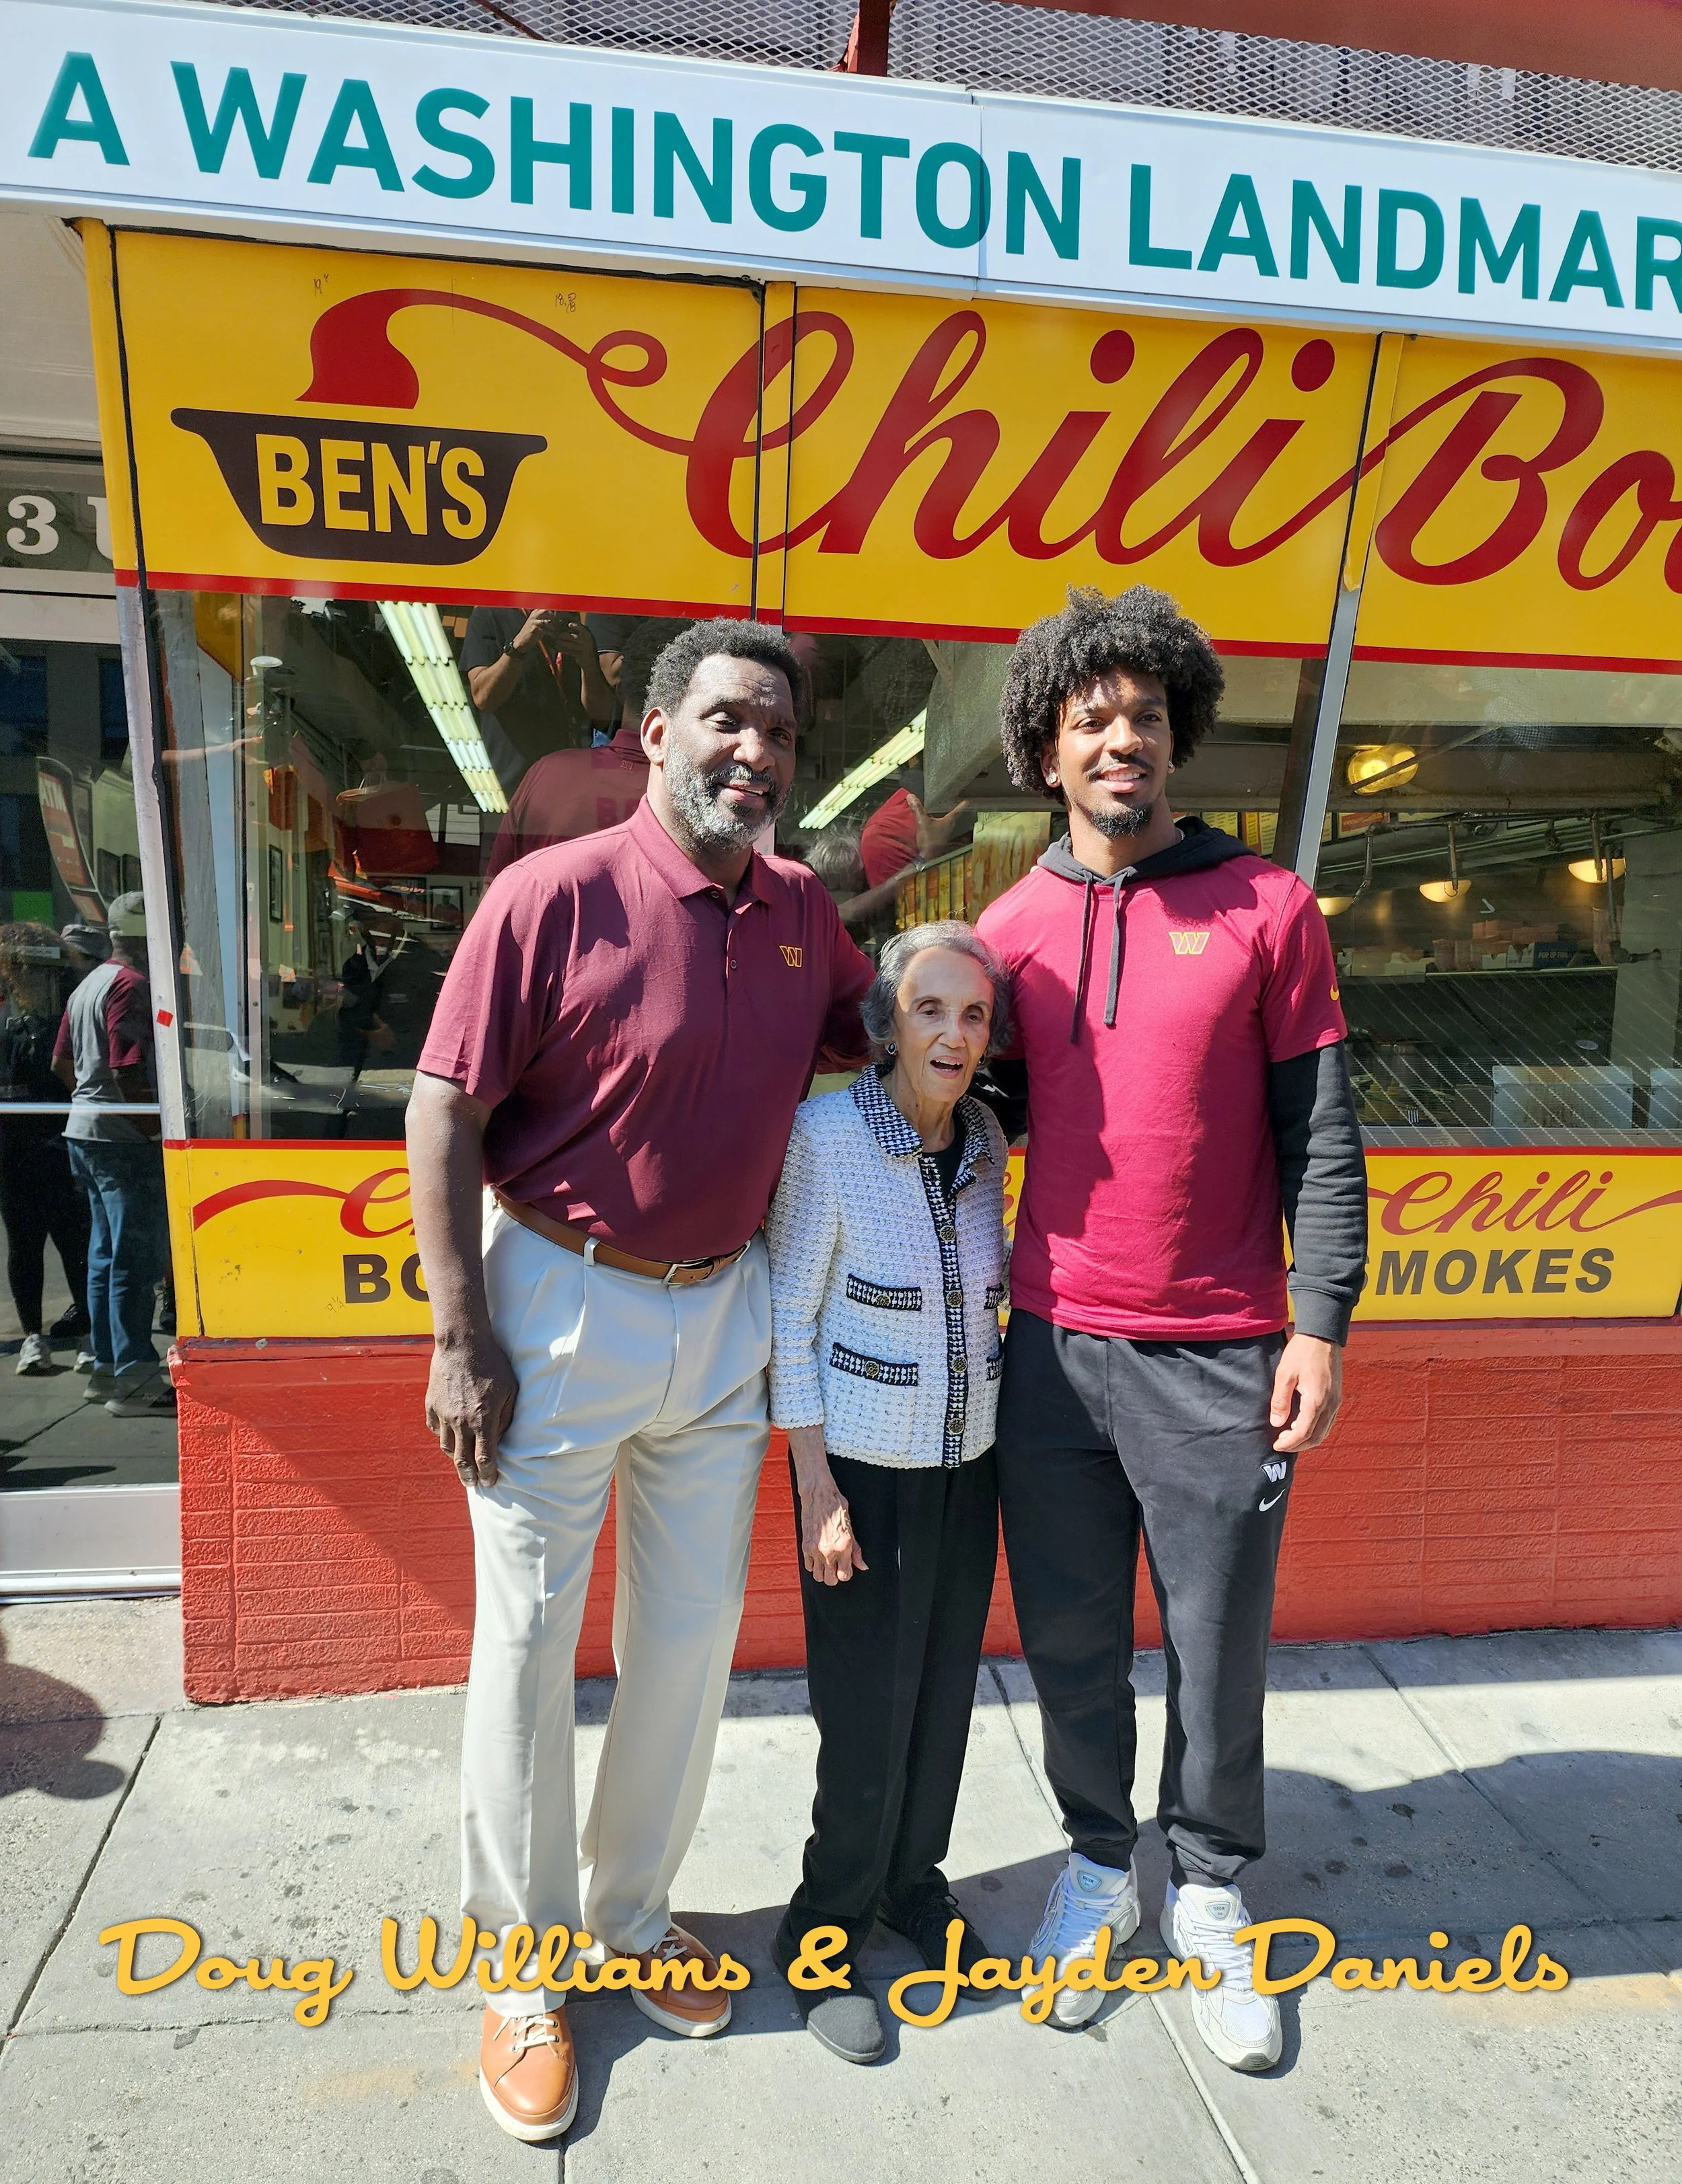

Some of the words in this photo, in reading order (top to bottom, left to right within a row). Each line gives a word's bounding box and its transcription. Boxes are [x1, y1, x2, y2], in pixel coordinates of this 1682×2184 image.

[28, 52, 130, 165] A
[170, 60, 1081, 260] WASHINGTON
[1128, 163, 1682, 313] LANDMAR
[256, 433, 486, 539] BEN'S
[686, 310, 1339, 568] Chili
[1375, 357, 1682, 595] Bo
[778, 945, 803, 967] W
[1167, 932, 1210, 955] W
[1380, 1170, 1618, 1236] Chili
[1362, 1248, 1615, 1295] MOKES
[1261, 1460, 1287, 1484] W
[1082, 1875, 1095, 1884] DIOR
